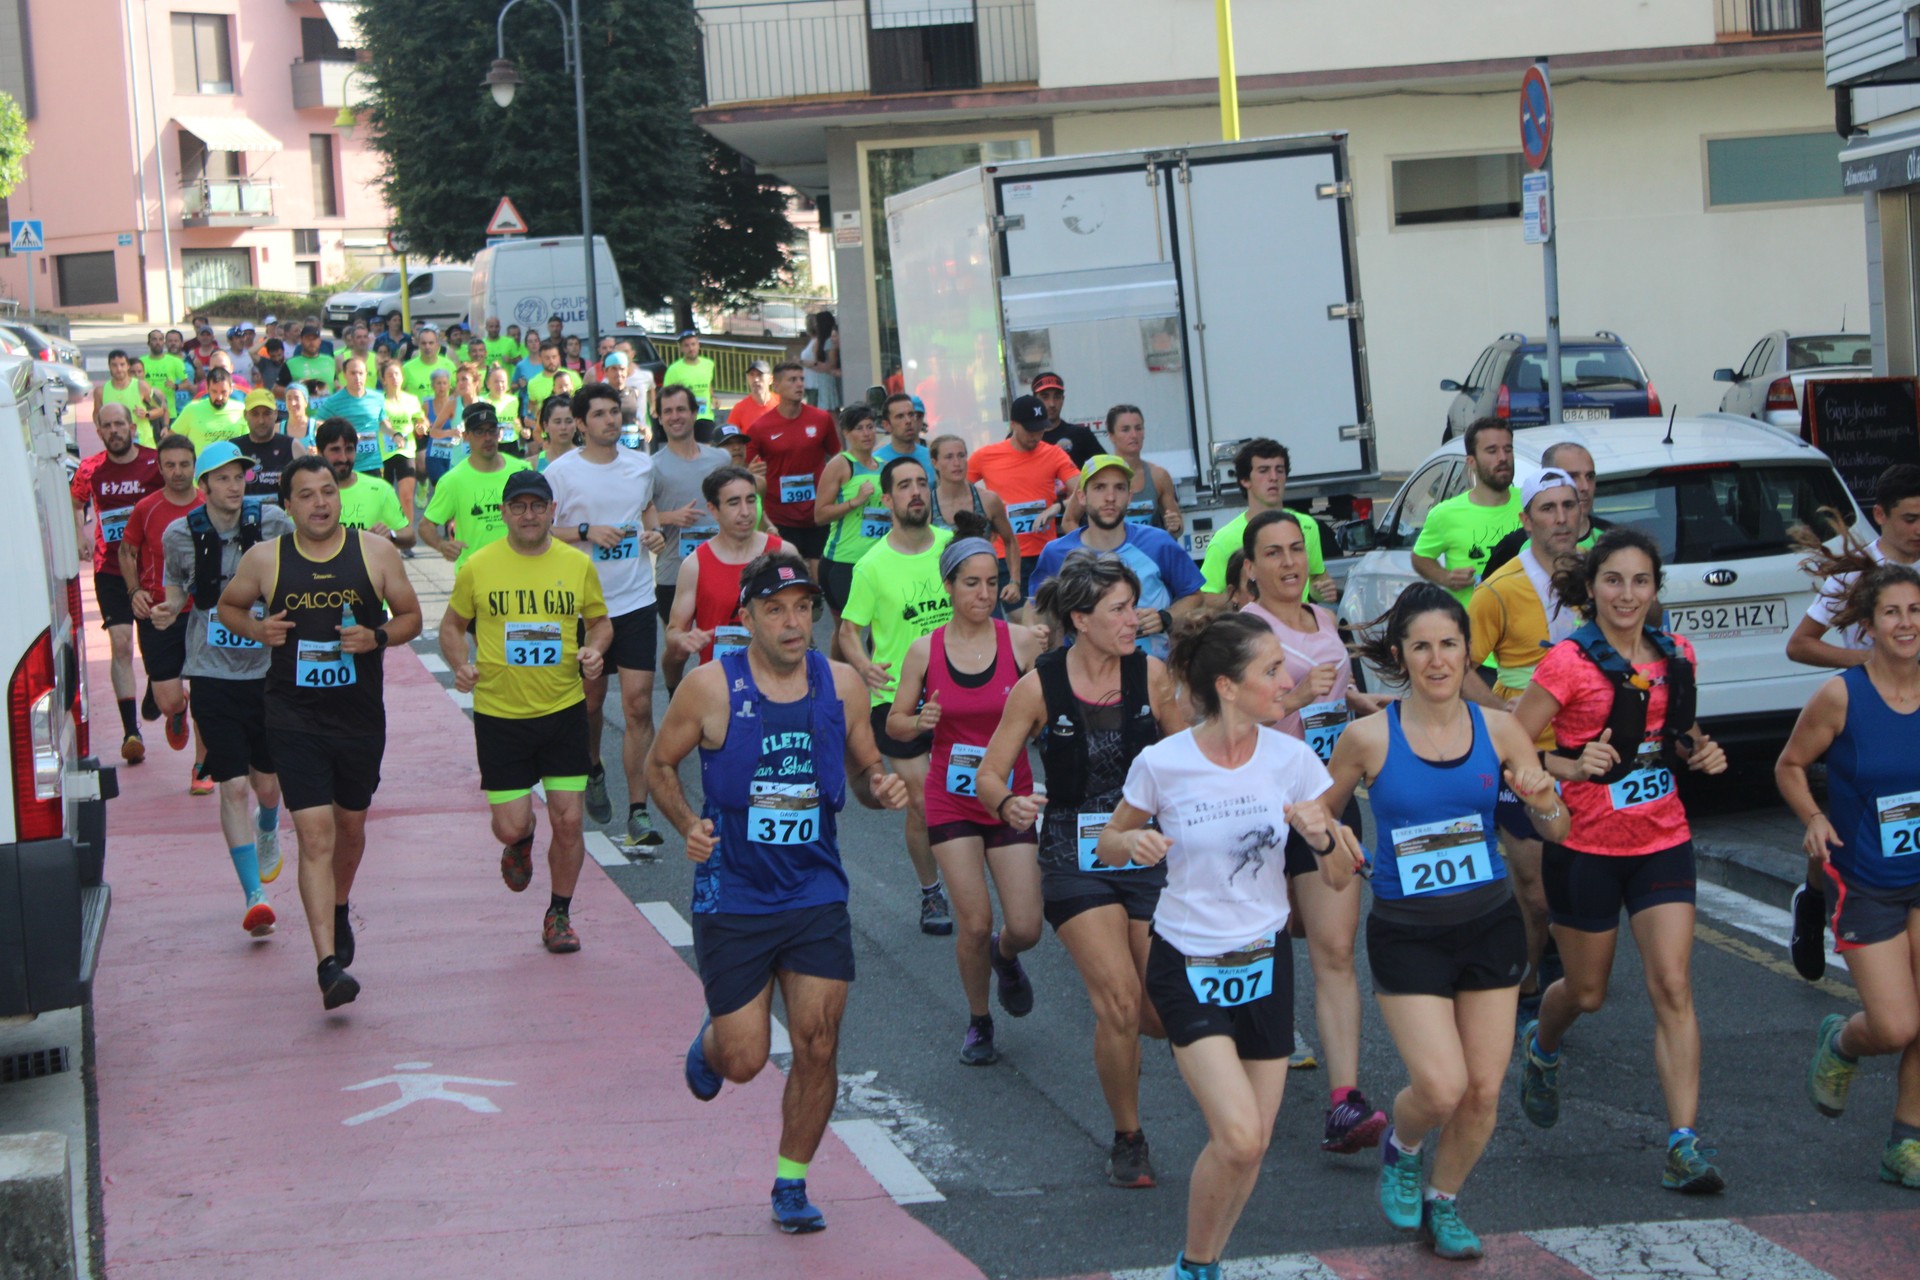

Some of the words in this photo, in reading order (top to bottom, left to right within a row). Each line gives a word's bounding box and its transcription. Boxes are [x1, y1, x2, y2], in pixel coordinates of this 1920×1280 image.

[551, 296, 588, 310] GRUP
[553, 311, 588, 323] EULE
[1564, 410, 1584, 420] 084
[358, 444, 376, 454] 353
[787, 489, 812, 503] 390
[108, 527, 125, 540] 28
[1016, 519, 1043, 534] 27
[1195, 535, 1215, 549] 95
[599, 543, 633, 560] 357
[1709, 571, 1734, 584] KIA
[902, 577, 943, 603] UXU
[285, 589, 364, 611] CALCOSA
[488, 591, 510, 616] SU
[515, 590, 538, 615] TA
[918, 597, 953, 613] TRAI
[1671, 608, 1729, 632] 7592
[1734, 604, 1776, 627] HZY
[513, 647, 556, 665] 312
[305, 666, 350, 686] 400
[1313, 733, 1340, 758] 21
[1622, 771, 1670, 805] 259
[758, 818, 813, 843] 370
[1411, 854, 1477, 891] 201
[1218, 967, 1249, 975] MAITANE
[1200, 970, 1264, 1004] 207
